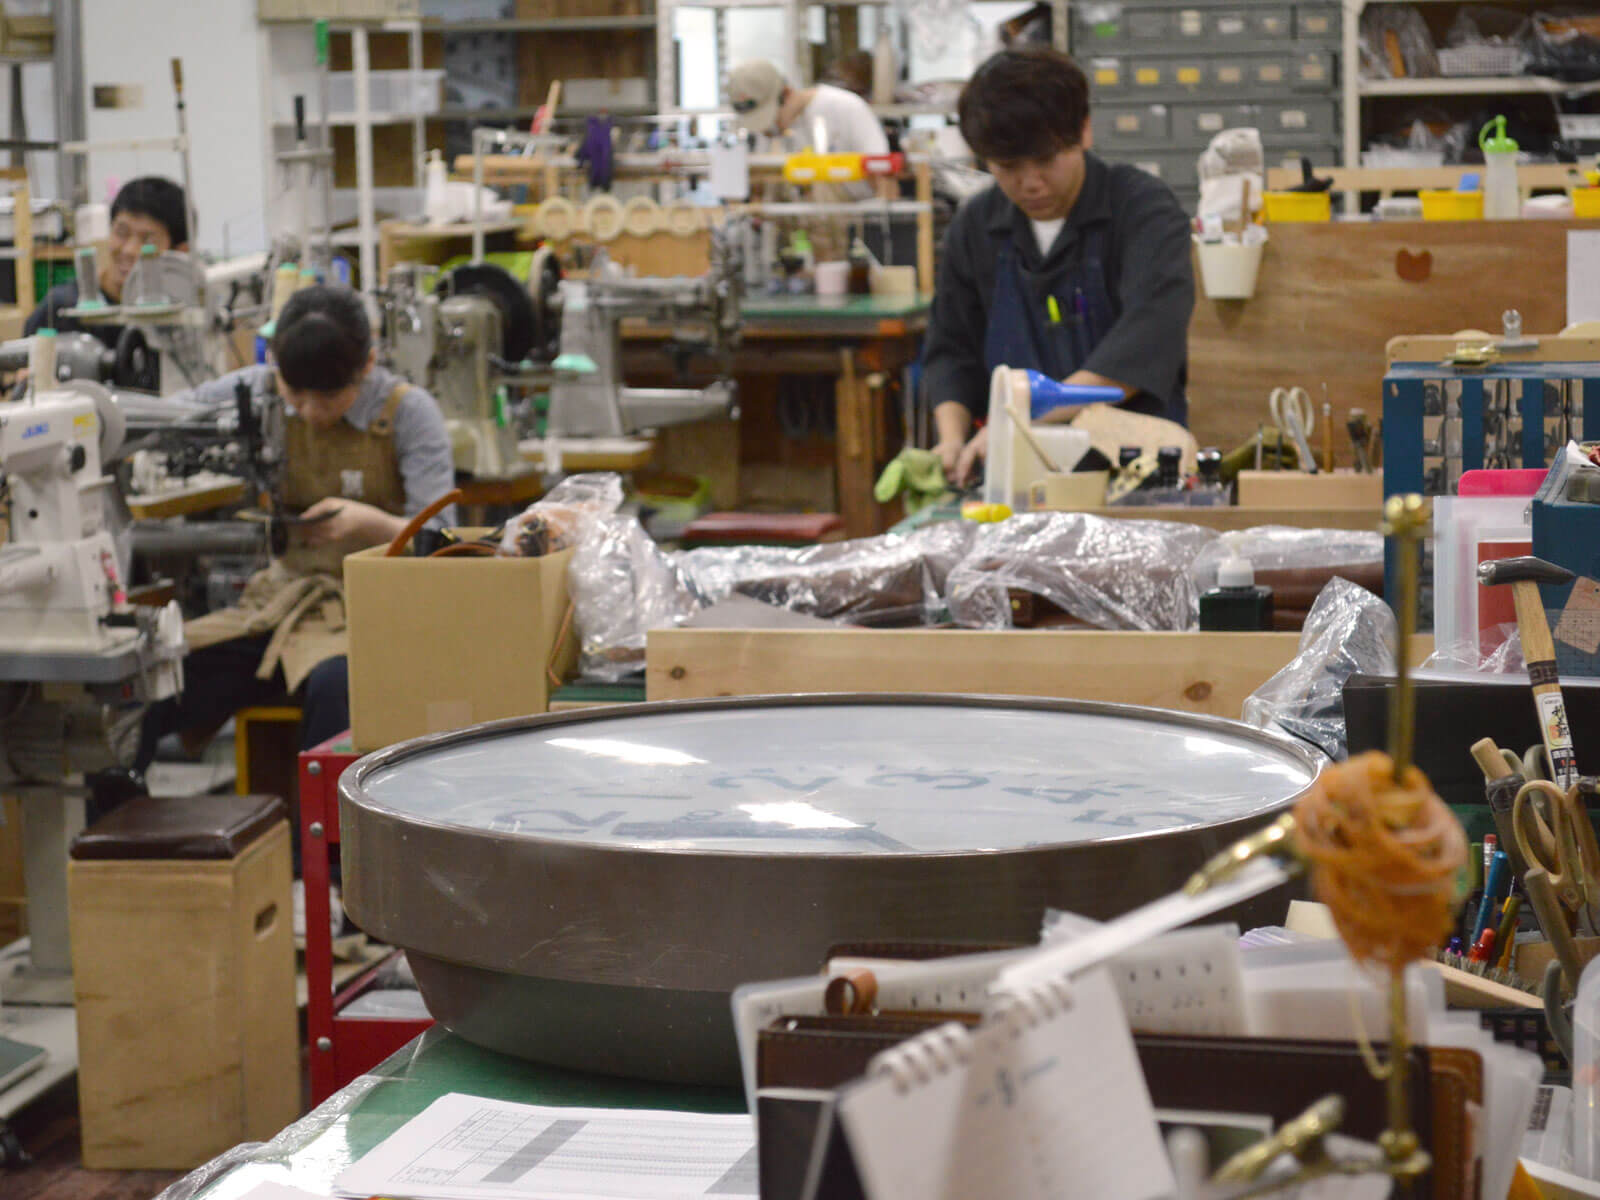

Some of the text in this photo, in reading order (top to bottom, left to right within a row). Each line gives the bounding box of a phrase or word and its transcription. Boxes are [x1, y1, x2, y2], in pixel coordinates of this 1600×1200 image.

[707, 774, 840, 791] 2
[866, 773, 991, 790] 3
[1001, 785, 1122, 805] 4
